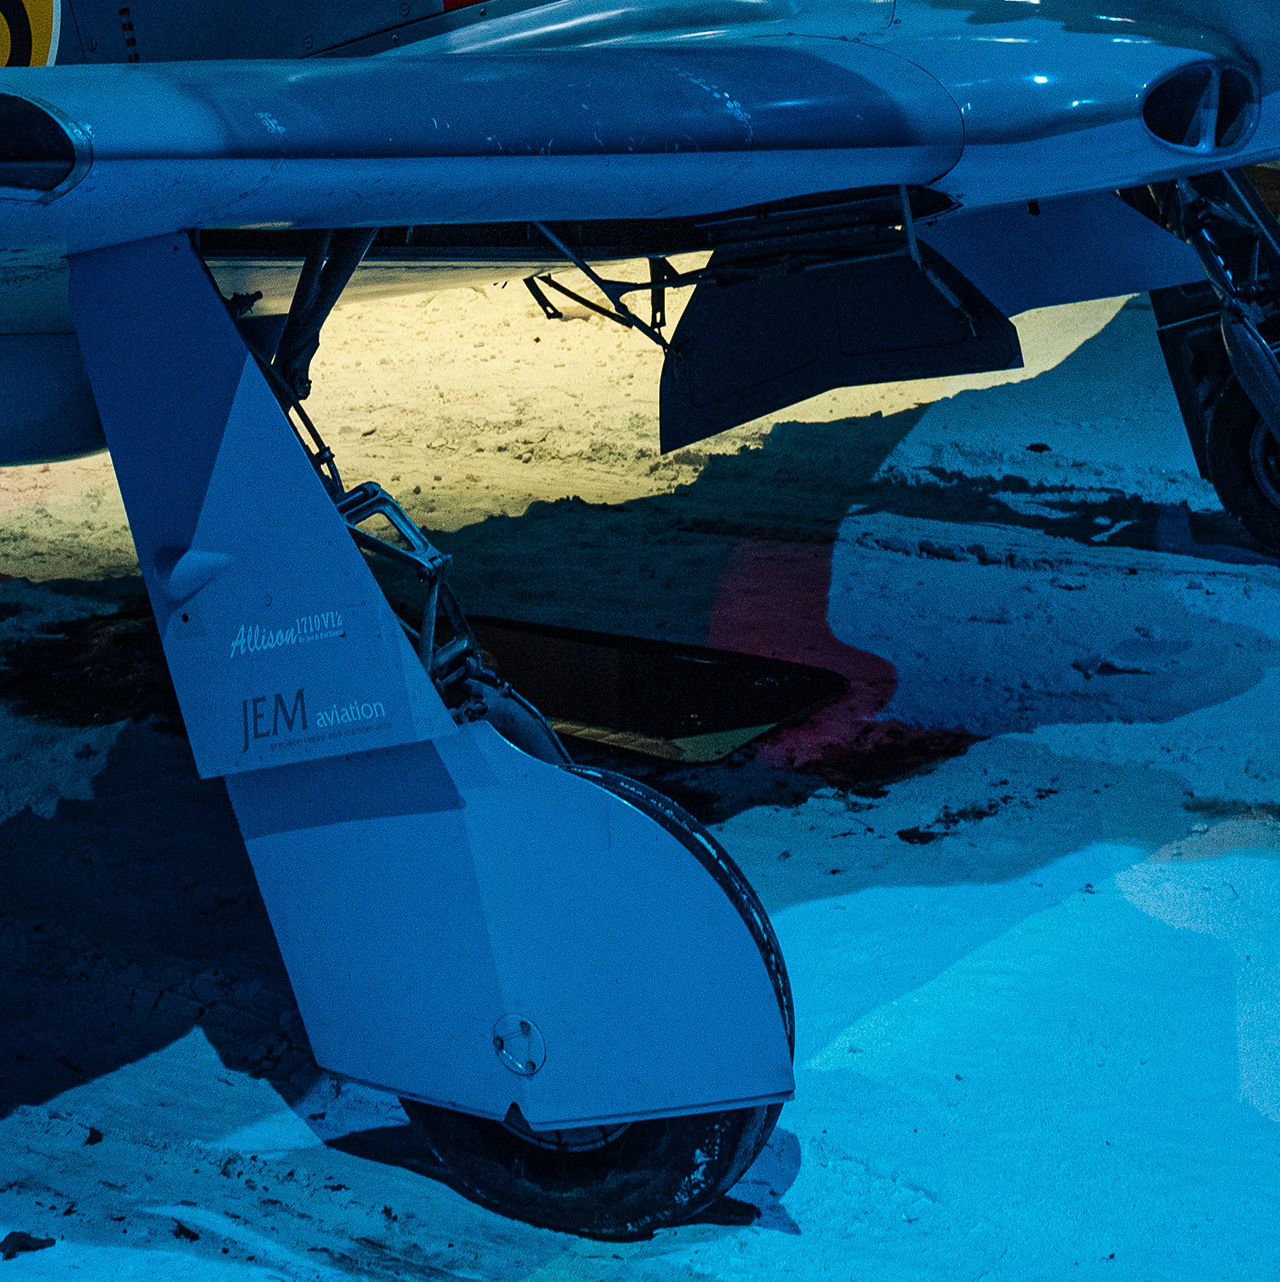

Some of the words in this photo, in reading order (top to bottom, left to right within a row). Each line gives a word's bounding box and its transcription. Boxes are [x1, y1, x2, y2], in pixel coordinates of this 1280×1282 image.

[230, 624, 298, 658] Allison
[241, 688, 308, 754] JEM
[316, 701, 385, 728] aviation
